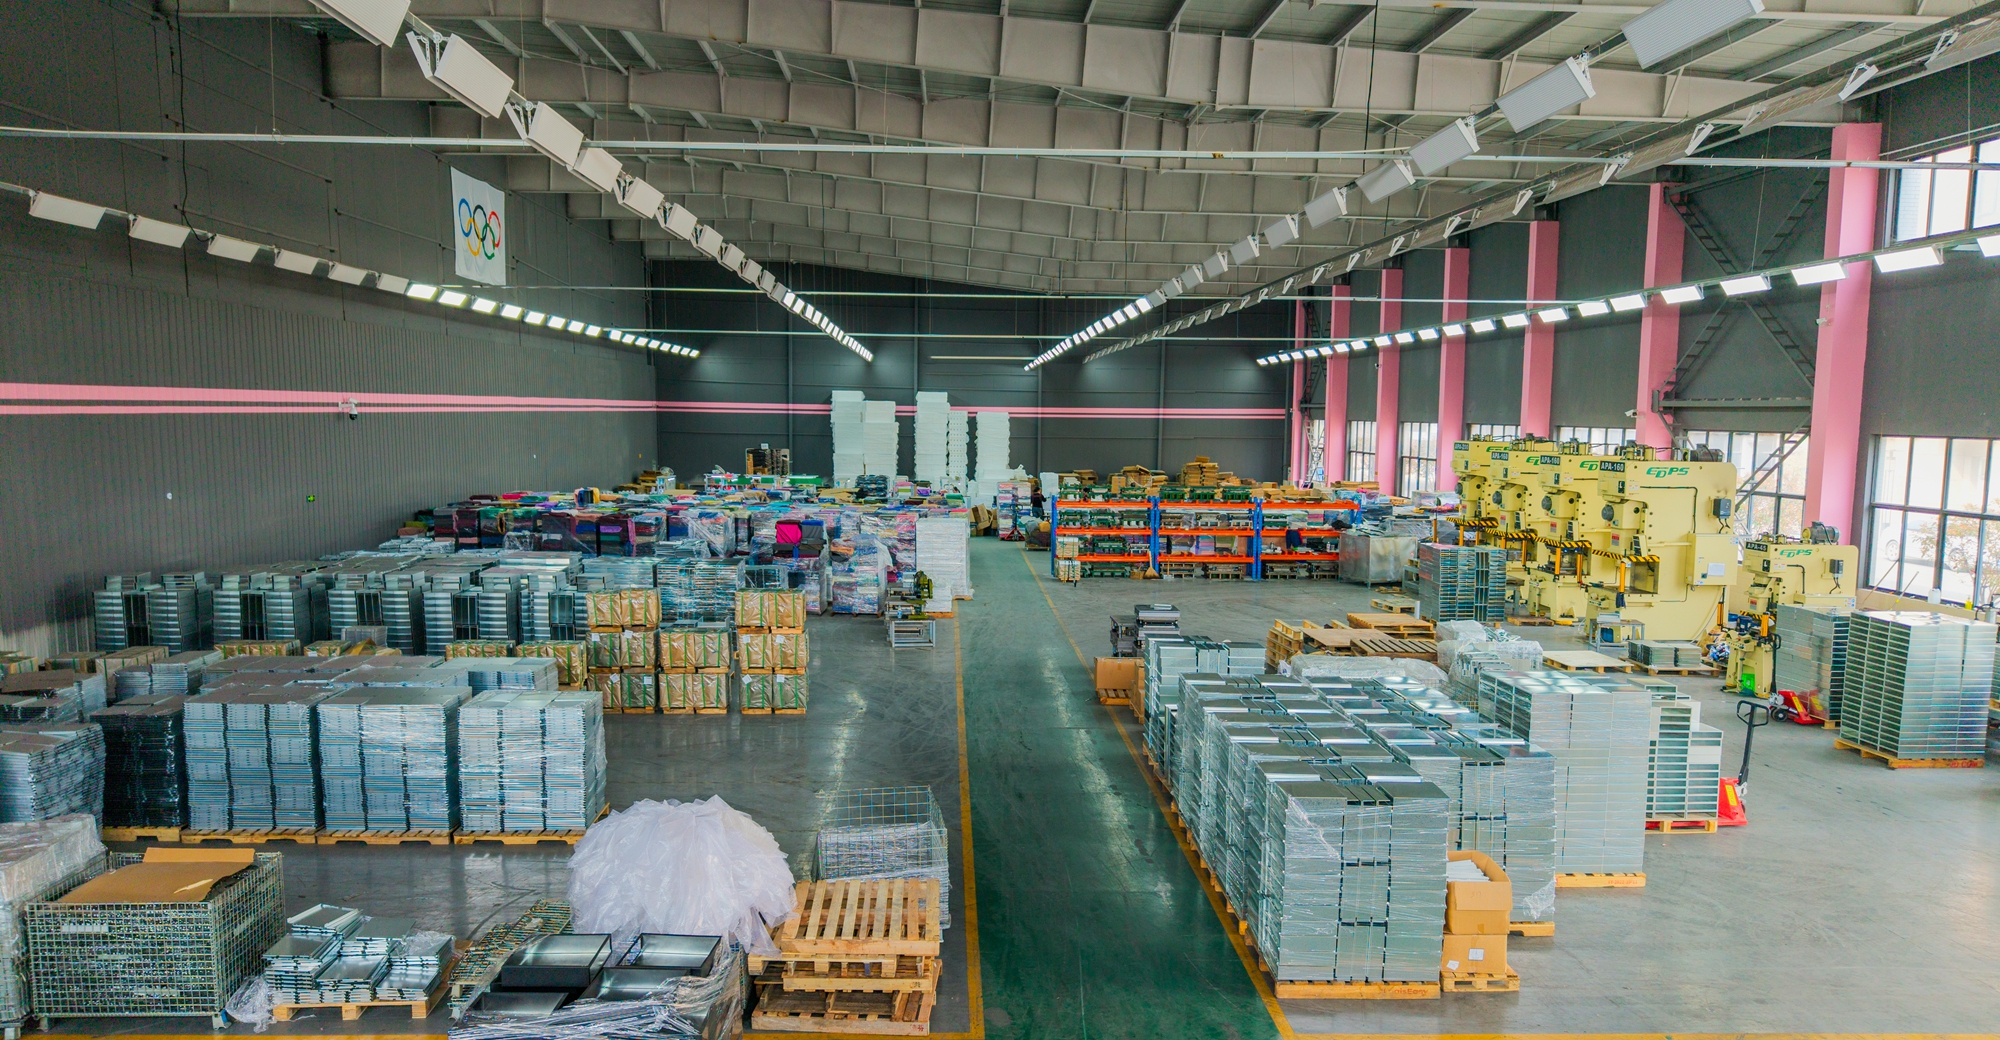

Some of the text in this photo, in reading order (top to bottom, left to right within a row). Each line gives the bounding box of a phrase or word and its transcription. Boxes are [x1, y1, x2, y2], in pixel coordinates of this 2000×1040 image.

[1541, 456, 1560, 465] APA-160
[1601, 462, 1624, 471] APA-160
[1646, 467, 1690, 478] EDPS
[1780, 549, 1812, 558] EDPS
